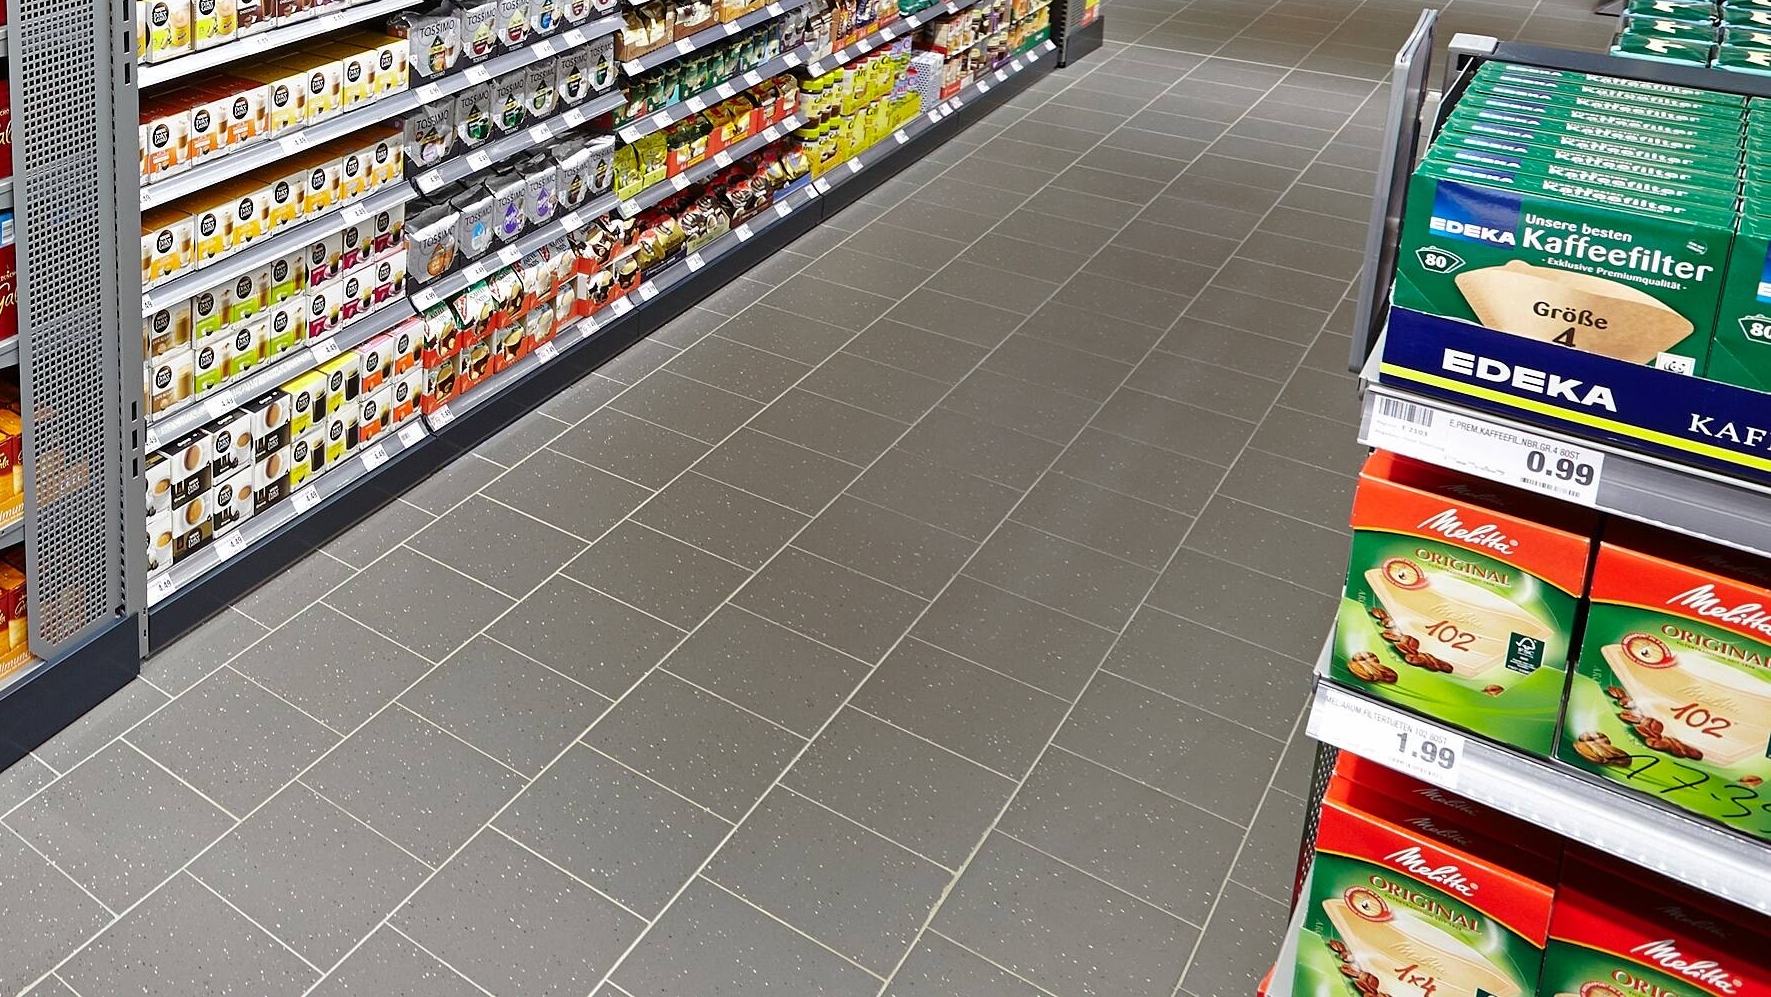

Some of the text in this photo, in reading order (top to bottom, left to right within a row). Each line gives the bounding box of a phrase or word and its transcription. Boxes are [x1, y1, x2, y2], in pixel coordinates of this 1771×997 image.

[420, 20, 455, 38] TOSSIMO
[416, 109, 449, 130] TOSSIMO
[1525, 213, 1632, 243] Unsere besten
[1425, 253, 1447, 268] 80
[1429, 216, 1714, 283] EDEKA Kaffeefilter
[1546, 257, 1681, 291] Exklusive Premiumqualität
[1533, 301, 1609, 330] Größe
[1552, 327, 1578, 348] 4
[1441, 348, 1617, 412] EDEKA
[1688, 413, 1771, 451] KAF
[1527, 450, 1595, 487] 0.99
[1416, 508, 1514, 555] Melitta
[1415, 547, 1512, 588] ORIGINAL
[1425, 620, 1476, 652] 102
[1670, 703, 1732, 739] 102
[1396, 732, 1455, 770] 1.99
[1383, 846, 1475, 897] Melitta
[1369, 875, 1482, 935] ORIGINAL
[1630, 939, 1739, 994] Melitta
